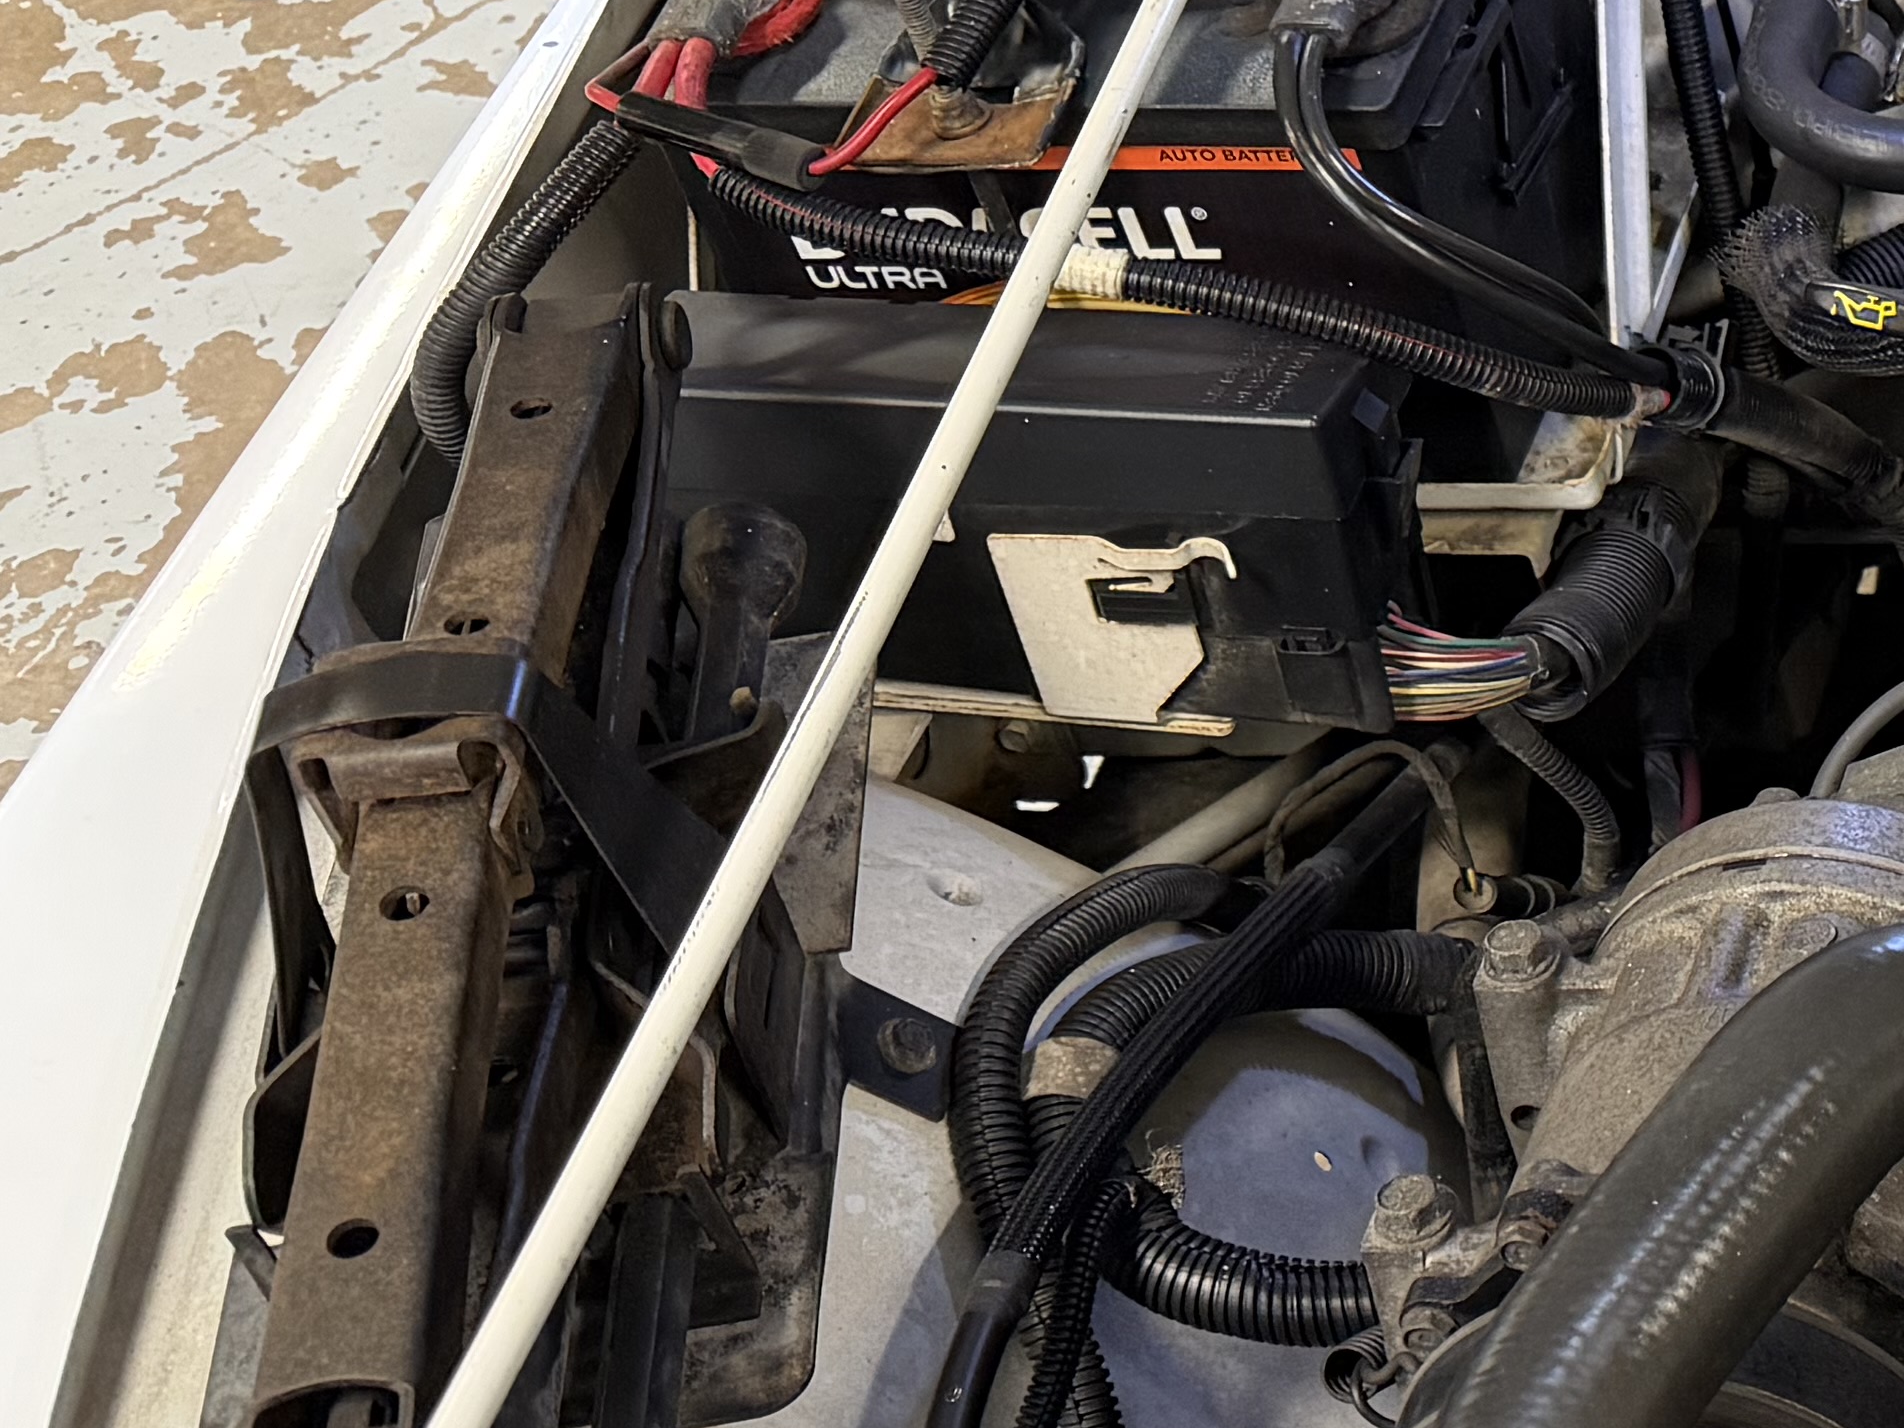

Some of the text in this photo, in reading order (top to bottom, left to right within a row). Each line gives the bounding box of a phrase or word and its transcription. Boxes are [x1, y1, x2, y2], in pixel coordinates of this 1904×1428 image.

[1159, 149, 1297, 163] AUTO BATTE
[806, 265, 947, 289] ULTRA
